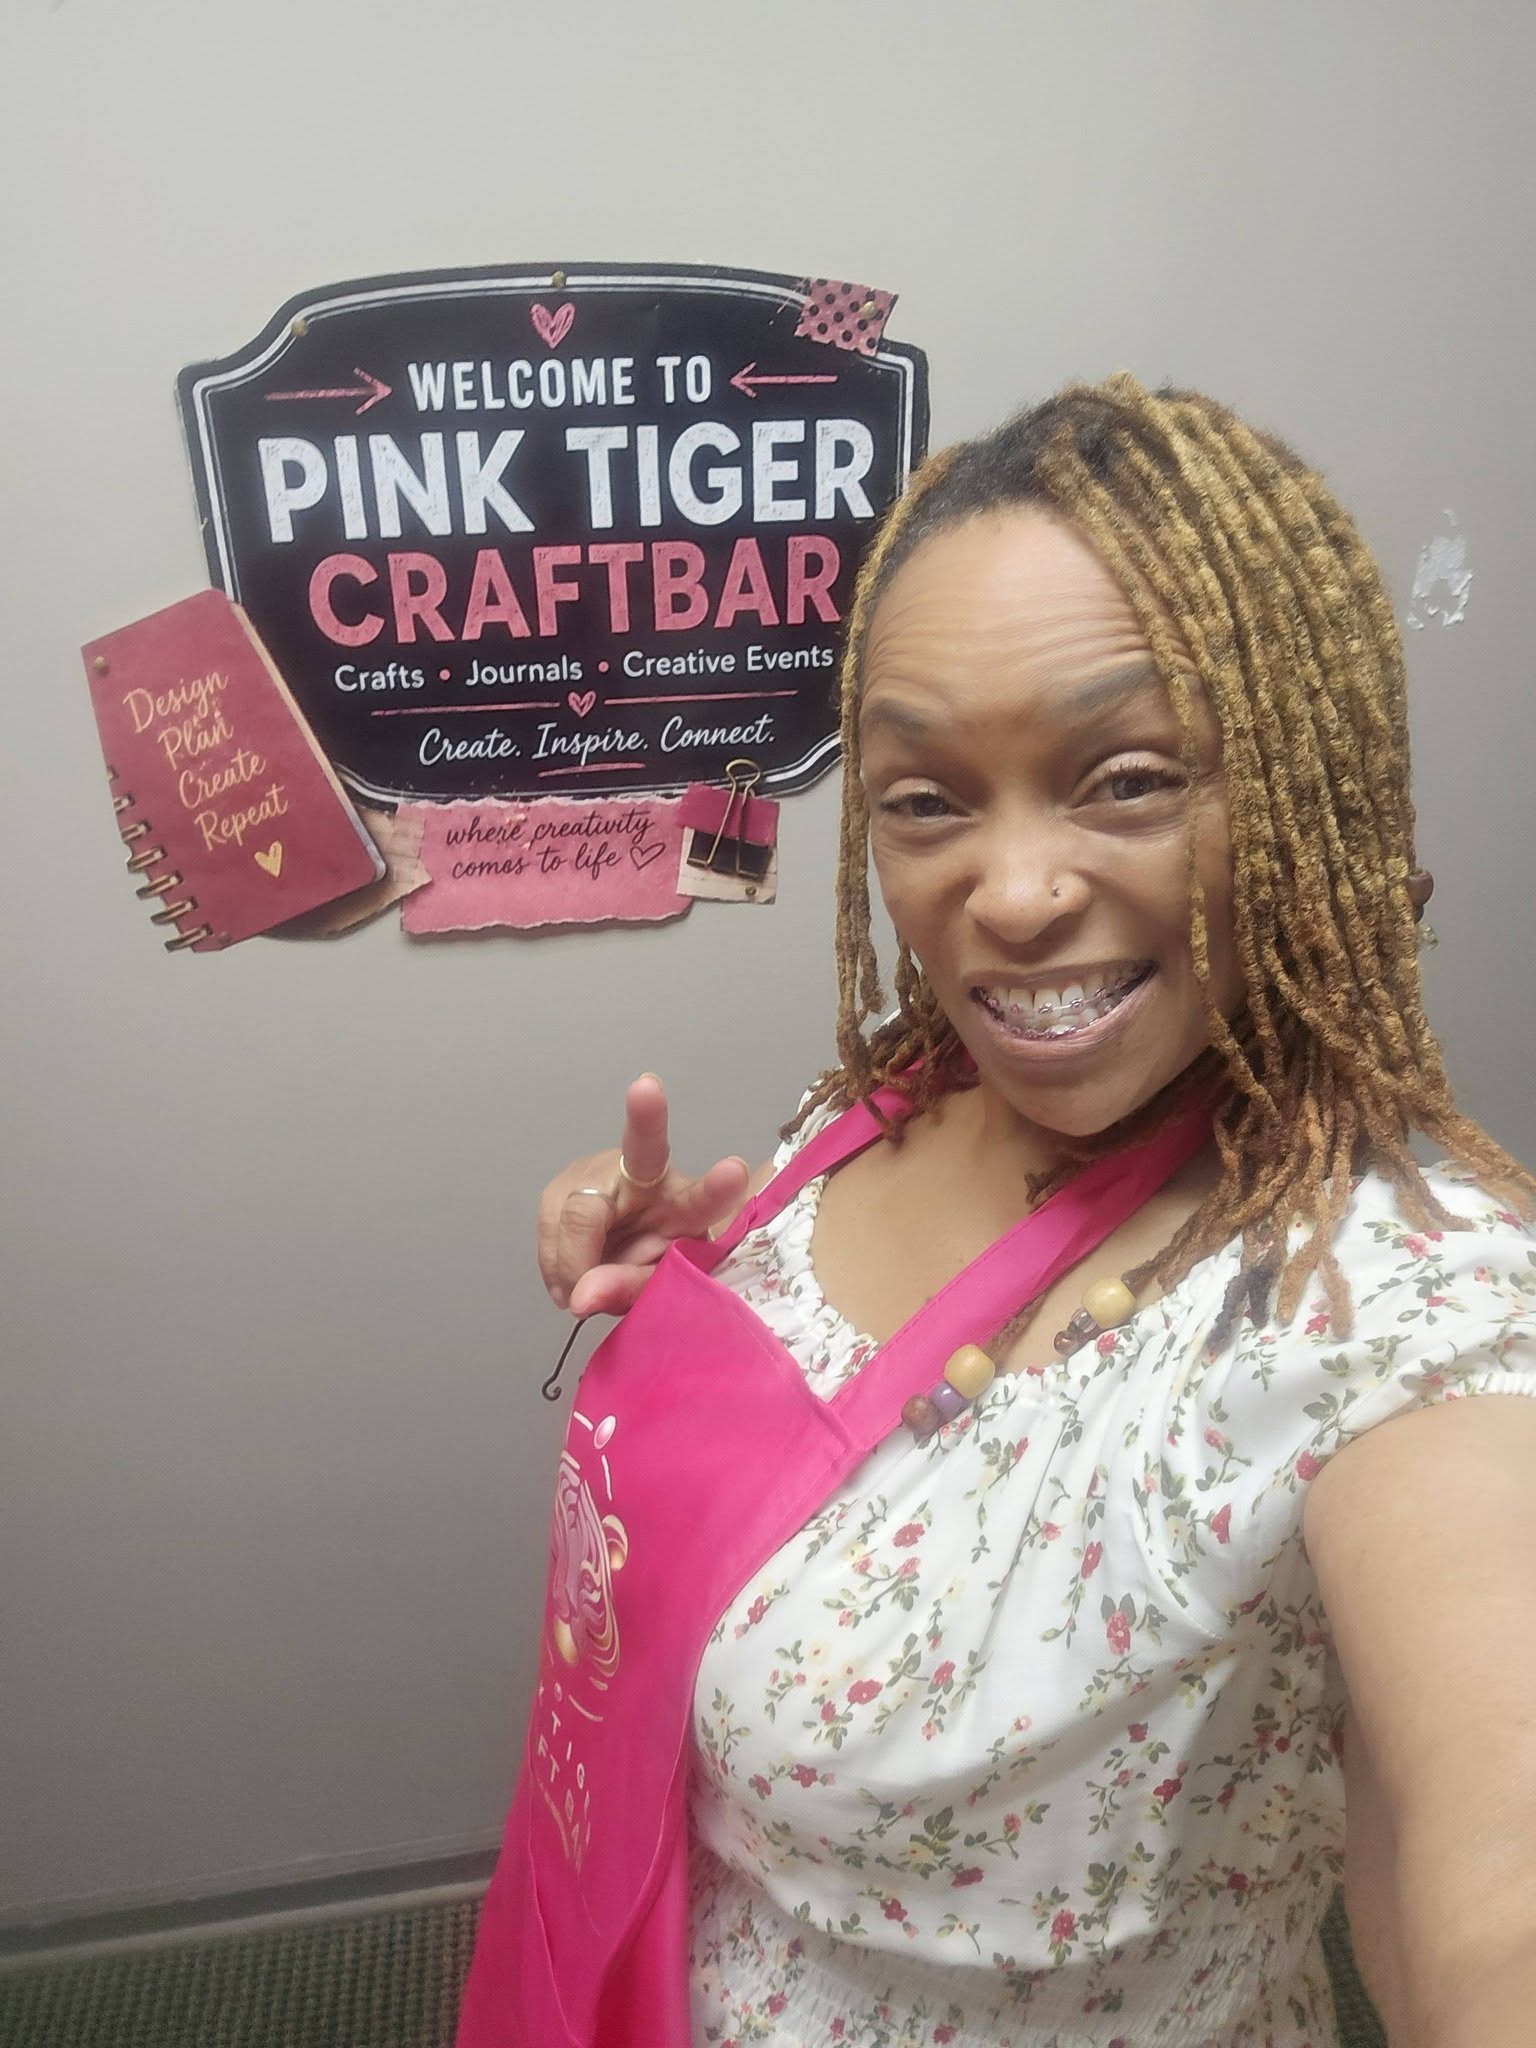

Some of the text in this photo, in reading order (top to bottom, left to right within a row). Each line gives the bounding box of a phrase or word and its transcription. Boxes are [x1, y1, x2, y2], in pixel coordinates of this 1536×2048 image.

[407, 354, 713, 412] WELCOME TO
[256, 417, 876, 544] PINK TIGER
[308, 534, 842, 647] CRAFTBAR
[334, 645, 834, 692] Crafts Journals Creative Events
[122, 671, 229, 733] Design
[157, 716, 234, 771] Plan
[418, 713, 776, 766] Create. Inspire. Connect.
[178, 747, 267, 809] Create
[193, 783, 289, 851] Repeat
[446, 808, 655, 845] where creativity
[536, 845, 568, 874] to
[574, 840, 622, 881] life
